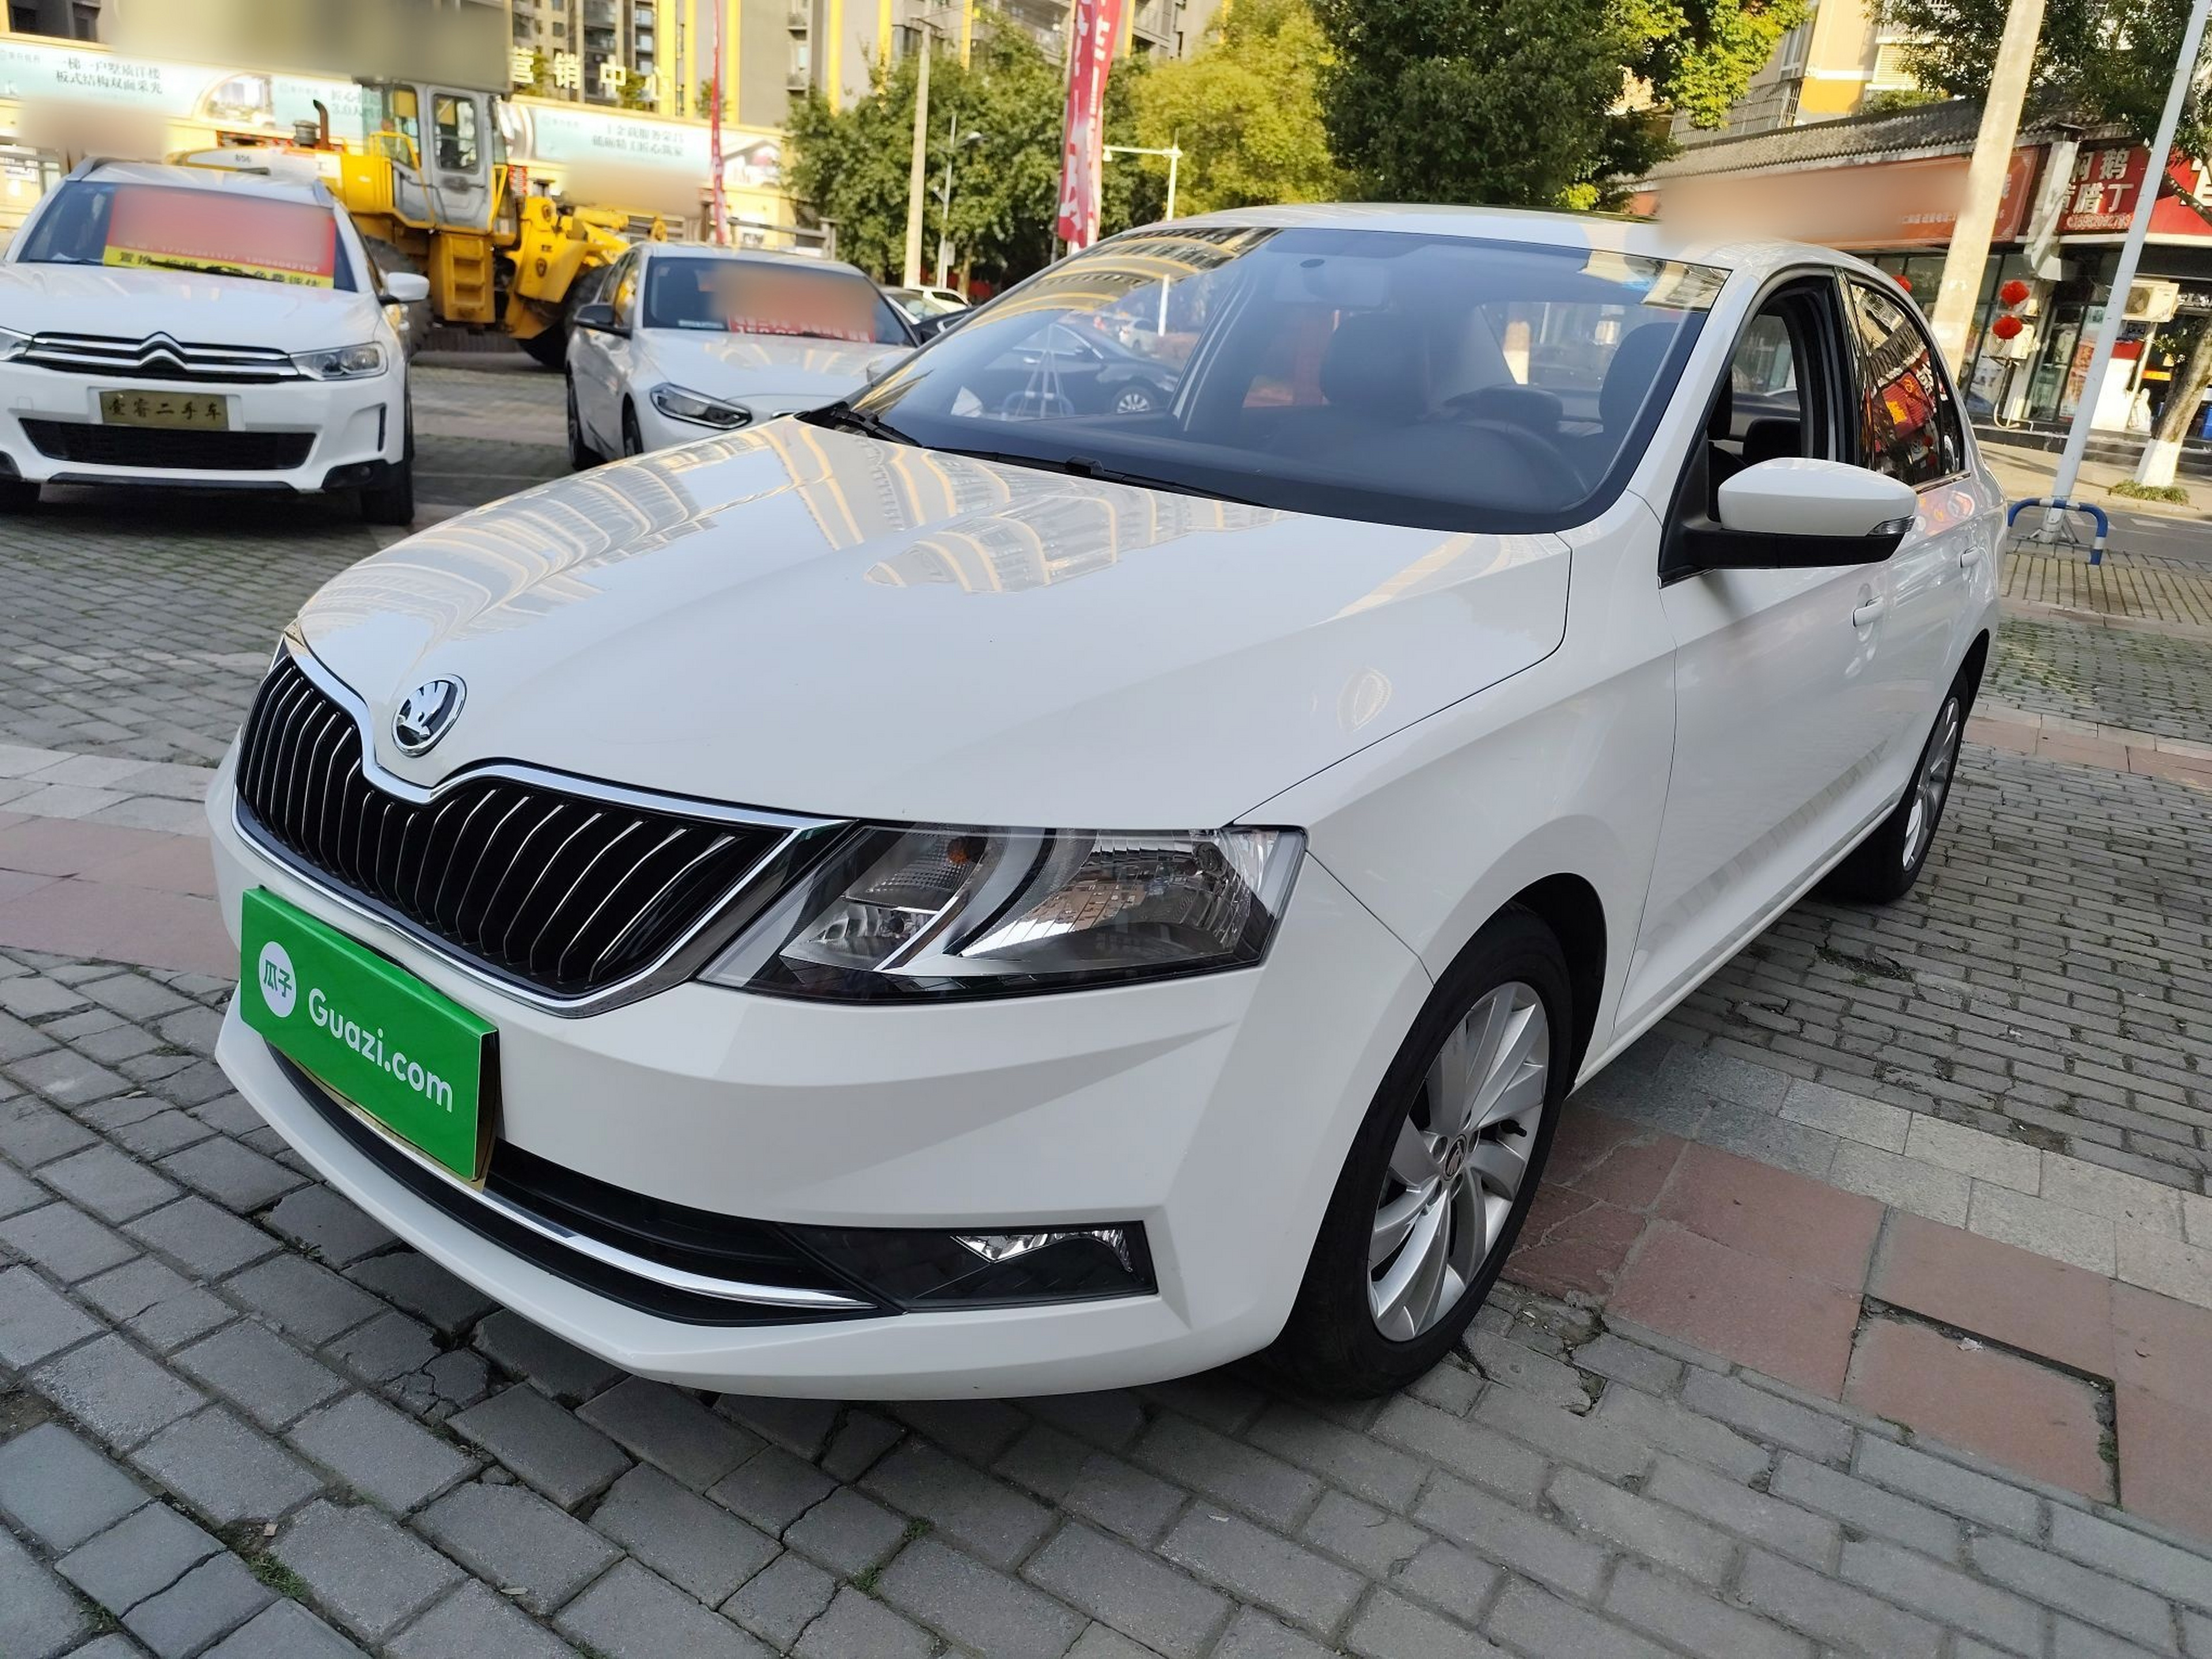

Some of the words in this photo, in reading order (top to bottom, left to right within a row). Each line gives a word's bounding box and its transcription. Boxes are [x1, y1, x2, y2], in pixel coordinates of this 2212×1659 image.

[512, 46, 672, 100] 营销中心
[263, 959, 293, 998] 瓜子
[308, 987, 453, 1113] Guazi.com
